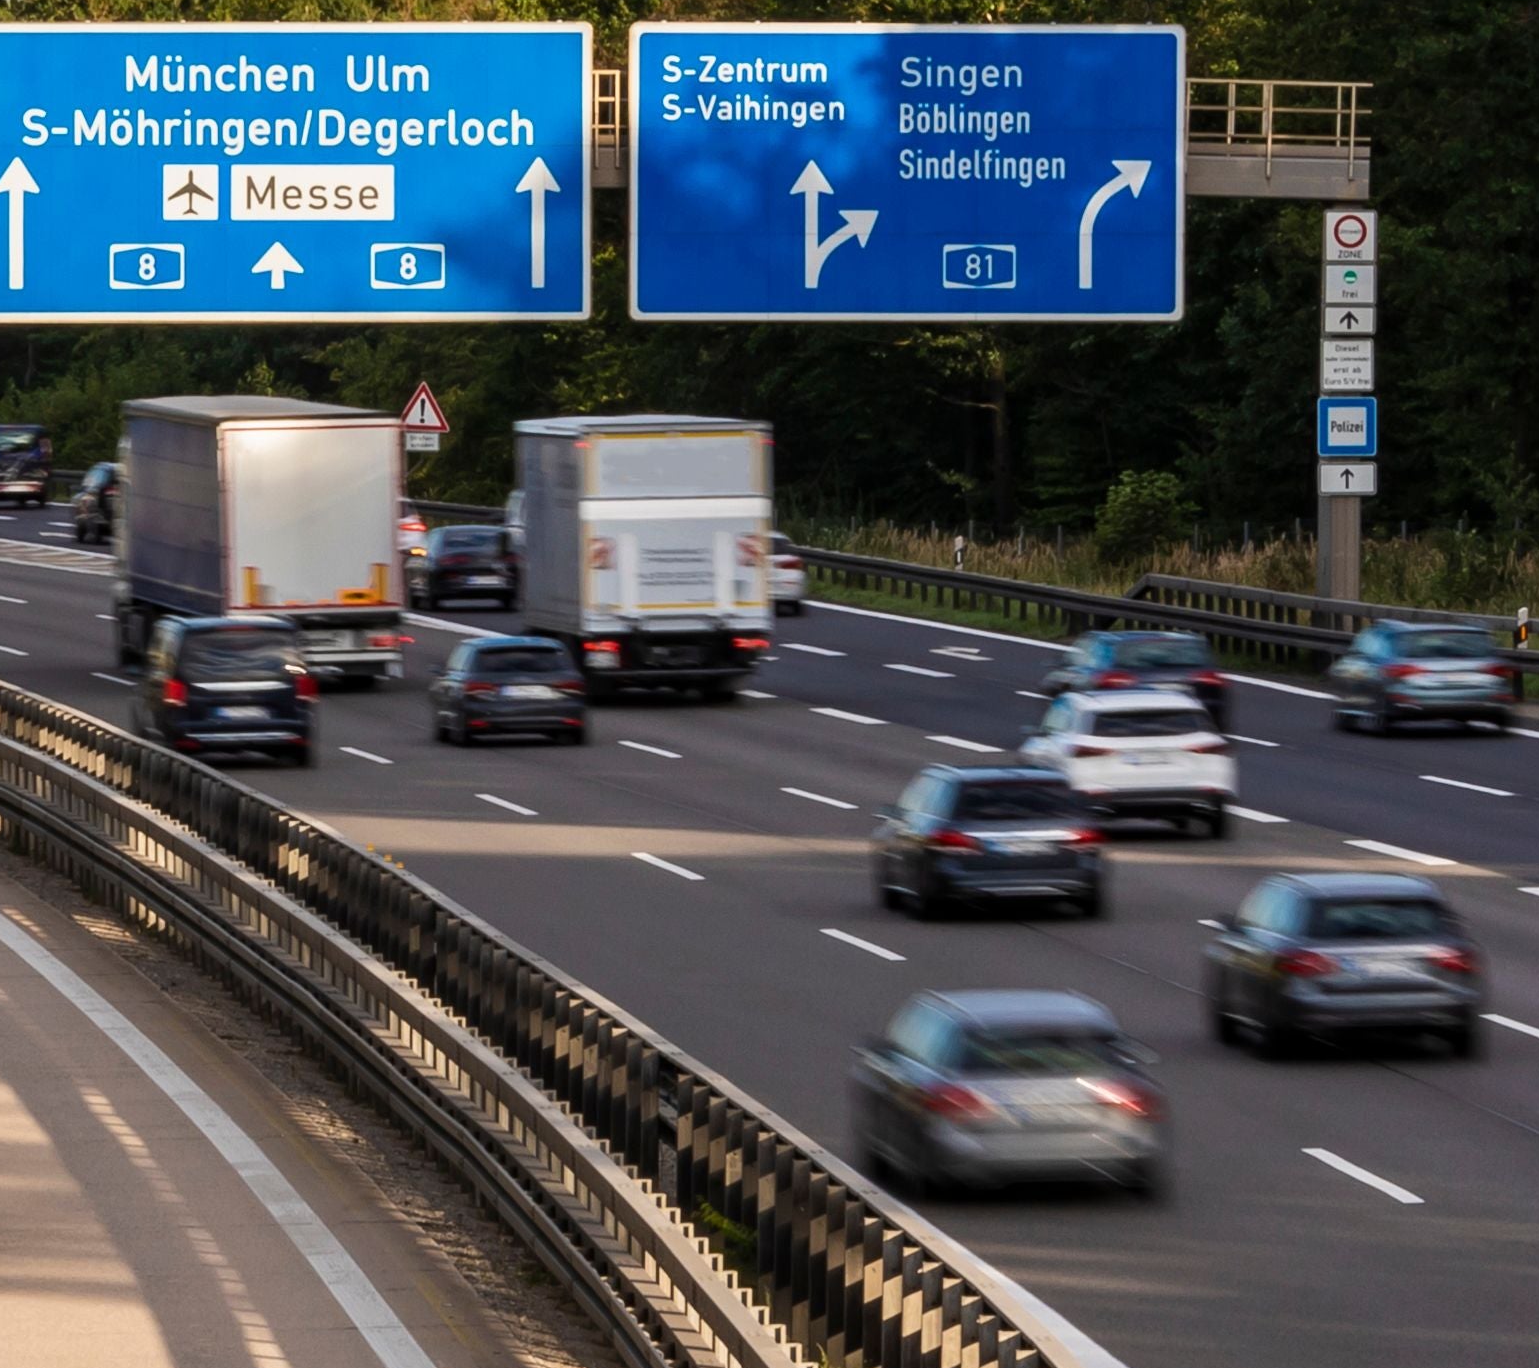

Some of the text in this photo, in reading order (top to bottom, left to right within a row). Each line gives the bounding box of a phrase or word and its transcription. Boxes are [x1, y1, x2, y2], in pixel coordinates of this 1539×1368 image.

[125, 55, 429, 92] München Ulm
[663, 56, 828, 83] S-Zentrum
[901, 57, 1022, 95] Singen
[663, 94, 845, 127] S-Vaihingen
[900, 103, 1030, 142] Böblingen
[22, 109, 534, 157] S-Möhringen/Degerloch
[899, 149, 1066, 188] Sindelfingen
[246, 176, 379, 210] Messe
[138, 253, 156, 281] 8
[400, 253, 418, 281] 8
[966, 254, 993, 280] 81
[1338, 249, 1363, 259] ZONE
[1342, 289, 1358, 298] frei
[1335, 344, 1360, 352] Diesel
[1331, 420, 1363, 433] Polizei
